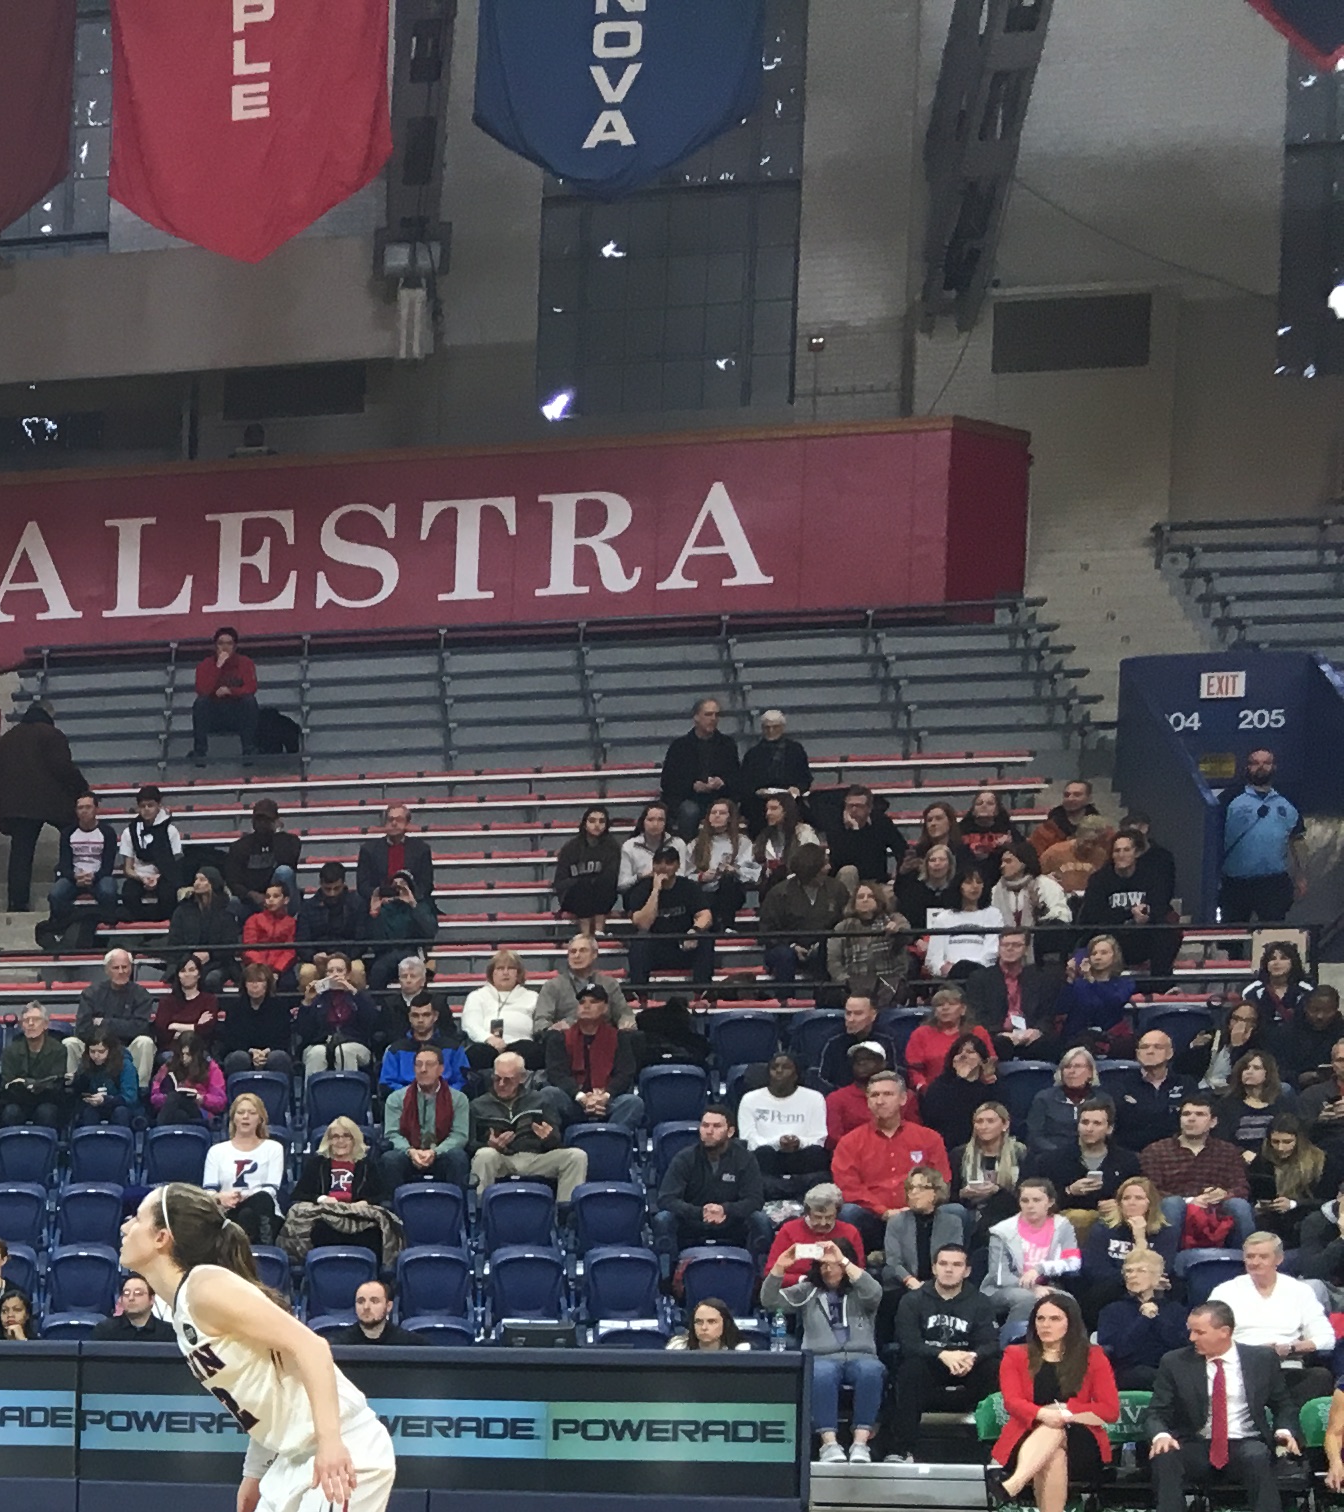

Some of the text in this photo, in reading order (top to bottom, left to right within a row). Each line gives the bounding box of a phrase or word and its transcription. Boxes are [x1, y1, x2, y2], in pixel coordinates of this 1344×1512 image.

[231, 0, 275, 121] PLE
[1207, 674, 1239, 696] EXIT
[1165, 709, 1286, 732] 04 205
[770, 1109, 805, 1122] Penn
[552, 1417, 788, 1443] POWERADE
